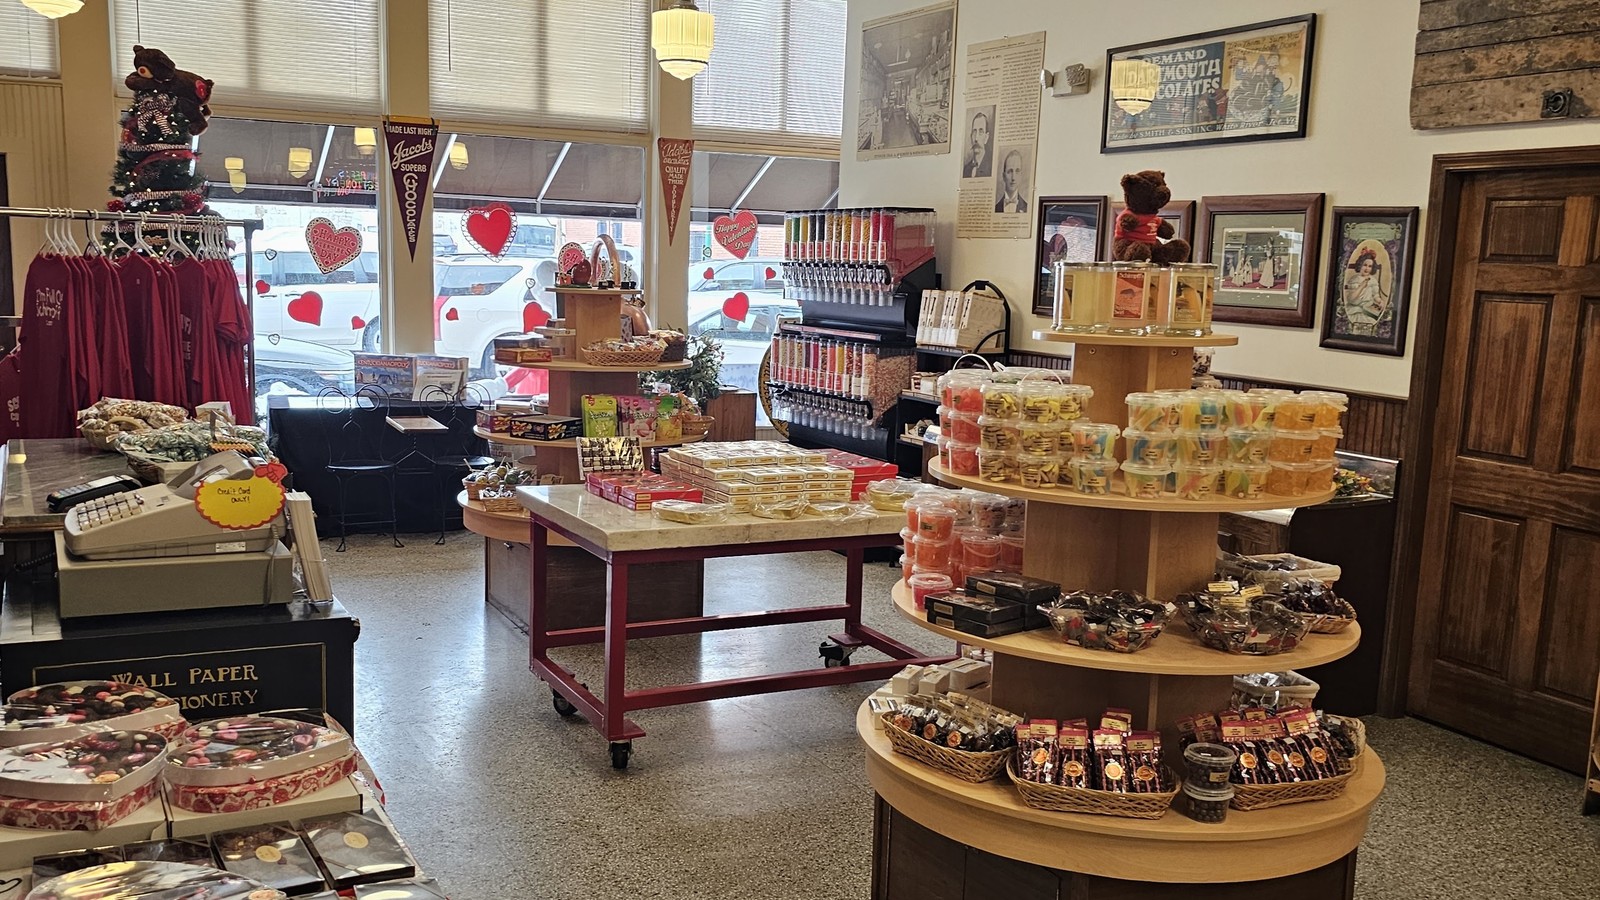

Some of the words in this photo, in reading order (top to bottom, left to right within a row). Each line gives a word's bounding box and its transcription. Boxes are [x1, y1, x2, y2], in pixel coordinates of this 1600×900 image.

[1142, 49, 1207, 65] DEMAND
[1127, 58, 1221, 88] DARTMOUTH
[418, 128, 438, 136] NIGH
[1140, 129, 1165, 138] SMITH
[1175, 127, 1192, 135] SON
[391, 138, 433, 169] Jacobs
[400, 164, 427, 172] SUPERB
[665, 166, 687, 174] QUALITY
[403, 173, 418, 243] CHOCOLATES
[715, 222, 740, 235] Happy
[319, 228, 351, 247] HAPPY
[217, 487, 236, 496] Credit
[238, 486, 251, 495] Card
[111, 671, 178, 688] WALL
[189, 664, 259, 685] PAPER
[173, 689, 258, 710] IONERY
